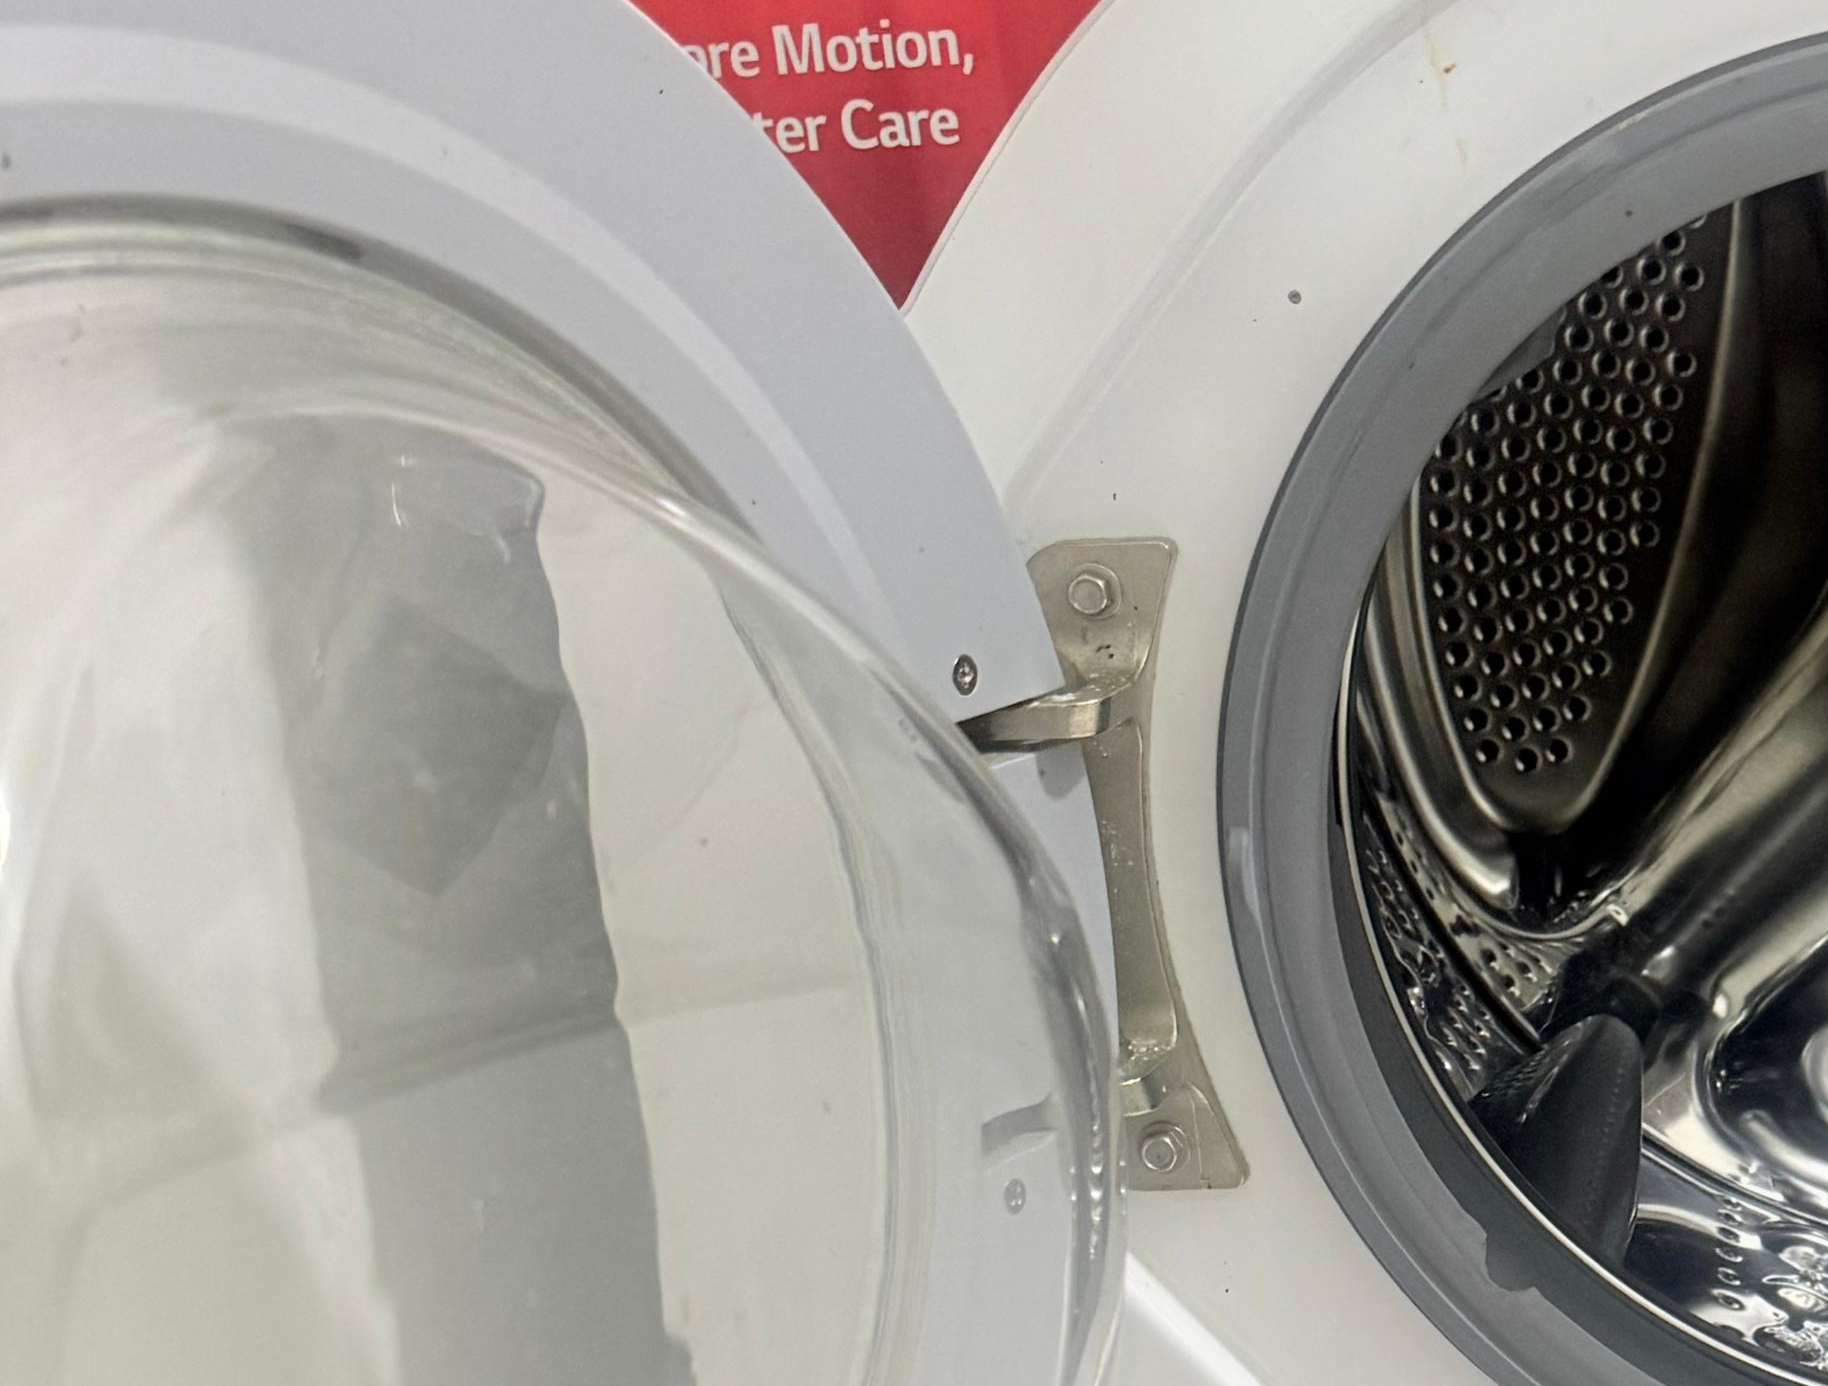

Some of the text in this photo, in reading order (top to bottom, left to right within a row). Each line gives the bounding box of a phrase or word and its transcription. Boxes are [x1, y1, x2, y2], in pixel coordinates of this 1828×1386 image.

[681, 18, 974, 79] ore Motion,
[841, 98, 960, 150] Care
